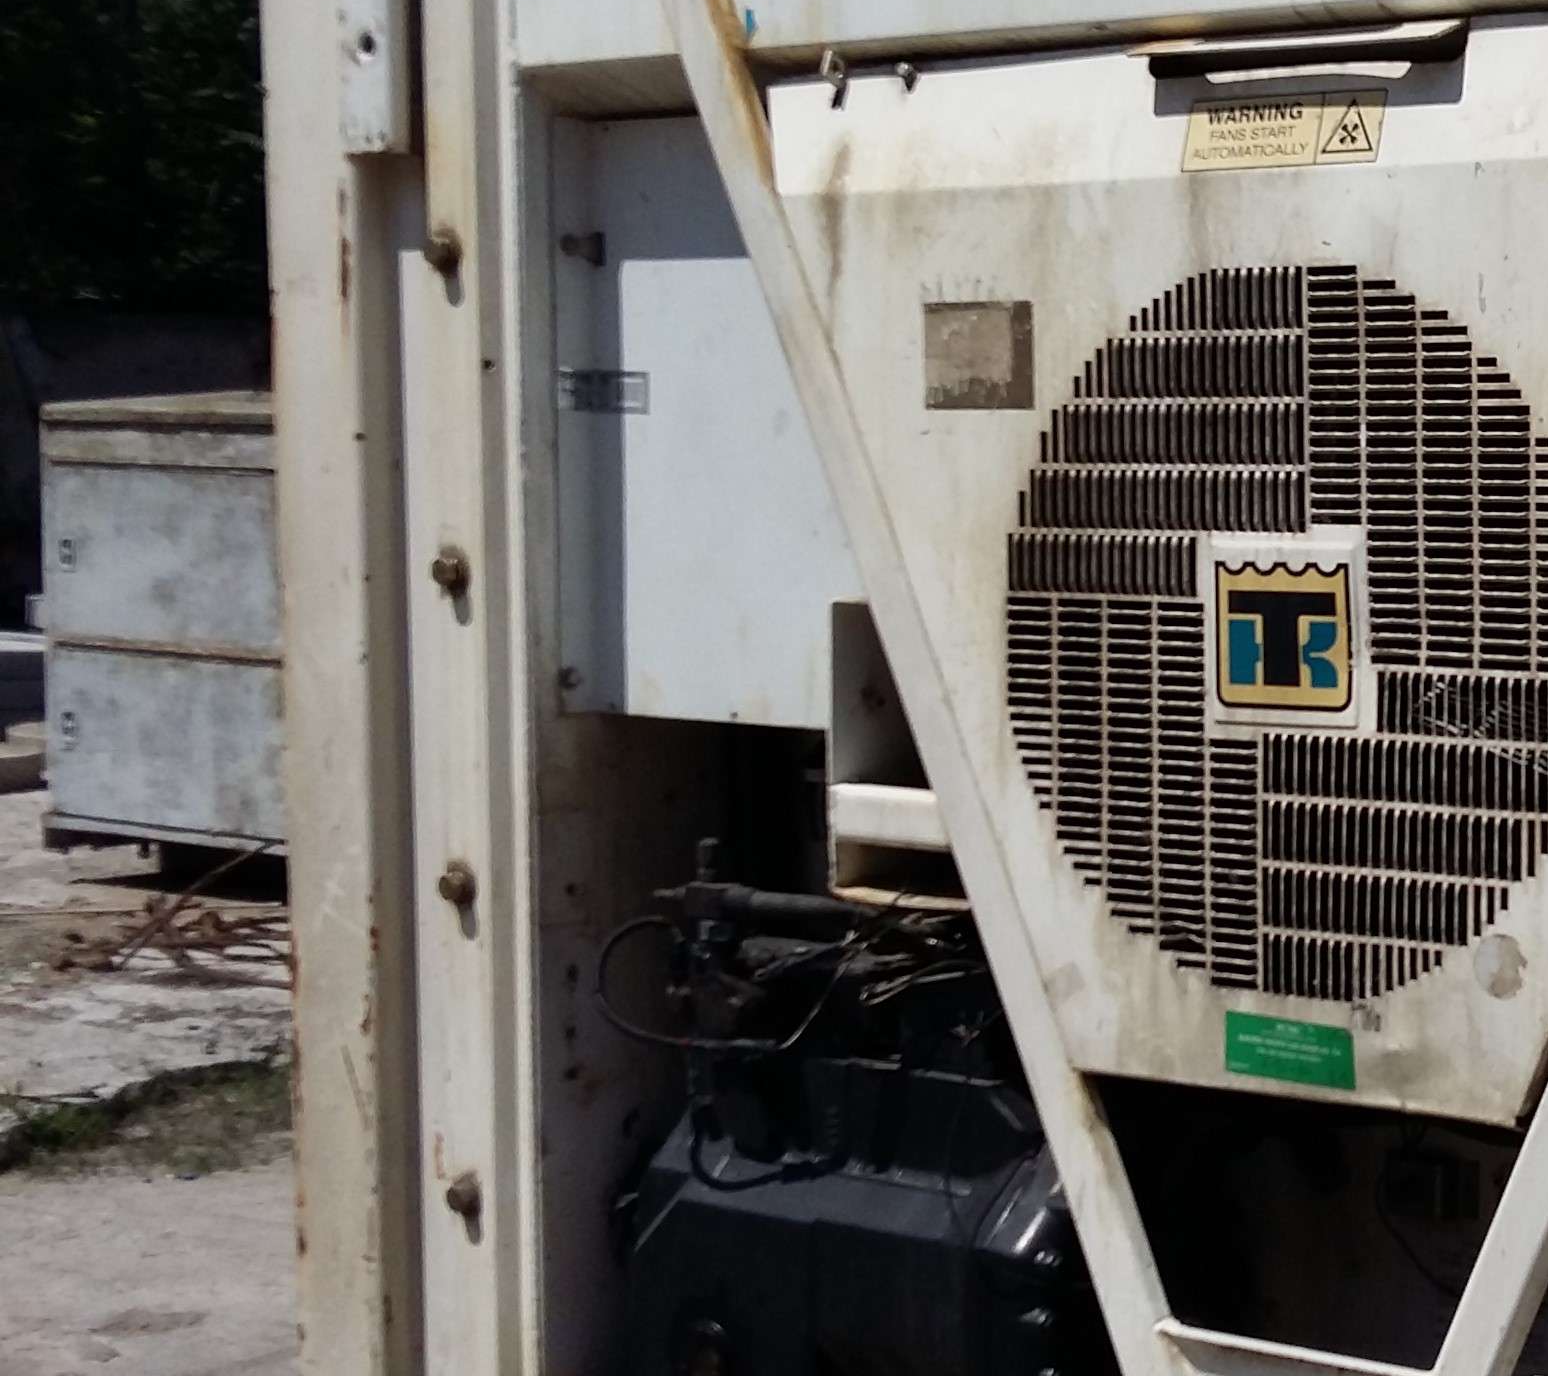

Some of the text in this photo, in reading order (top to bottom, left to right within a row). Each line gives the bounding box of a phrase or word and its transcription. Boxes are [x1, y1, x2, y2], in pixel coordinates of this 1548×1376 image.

[1207, 102, 1304, 126] WARNING
[1209, 125, 1297, 143] FANS START
[1192, 142, 1309, 161] AUTOMATICALLY
